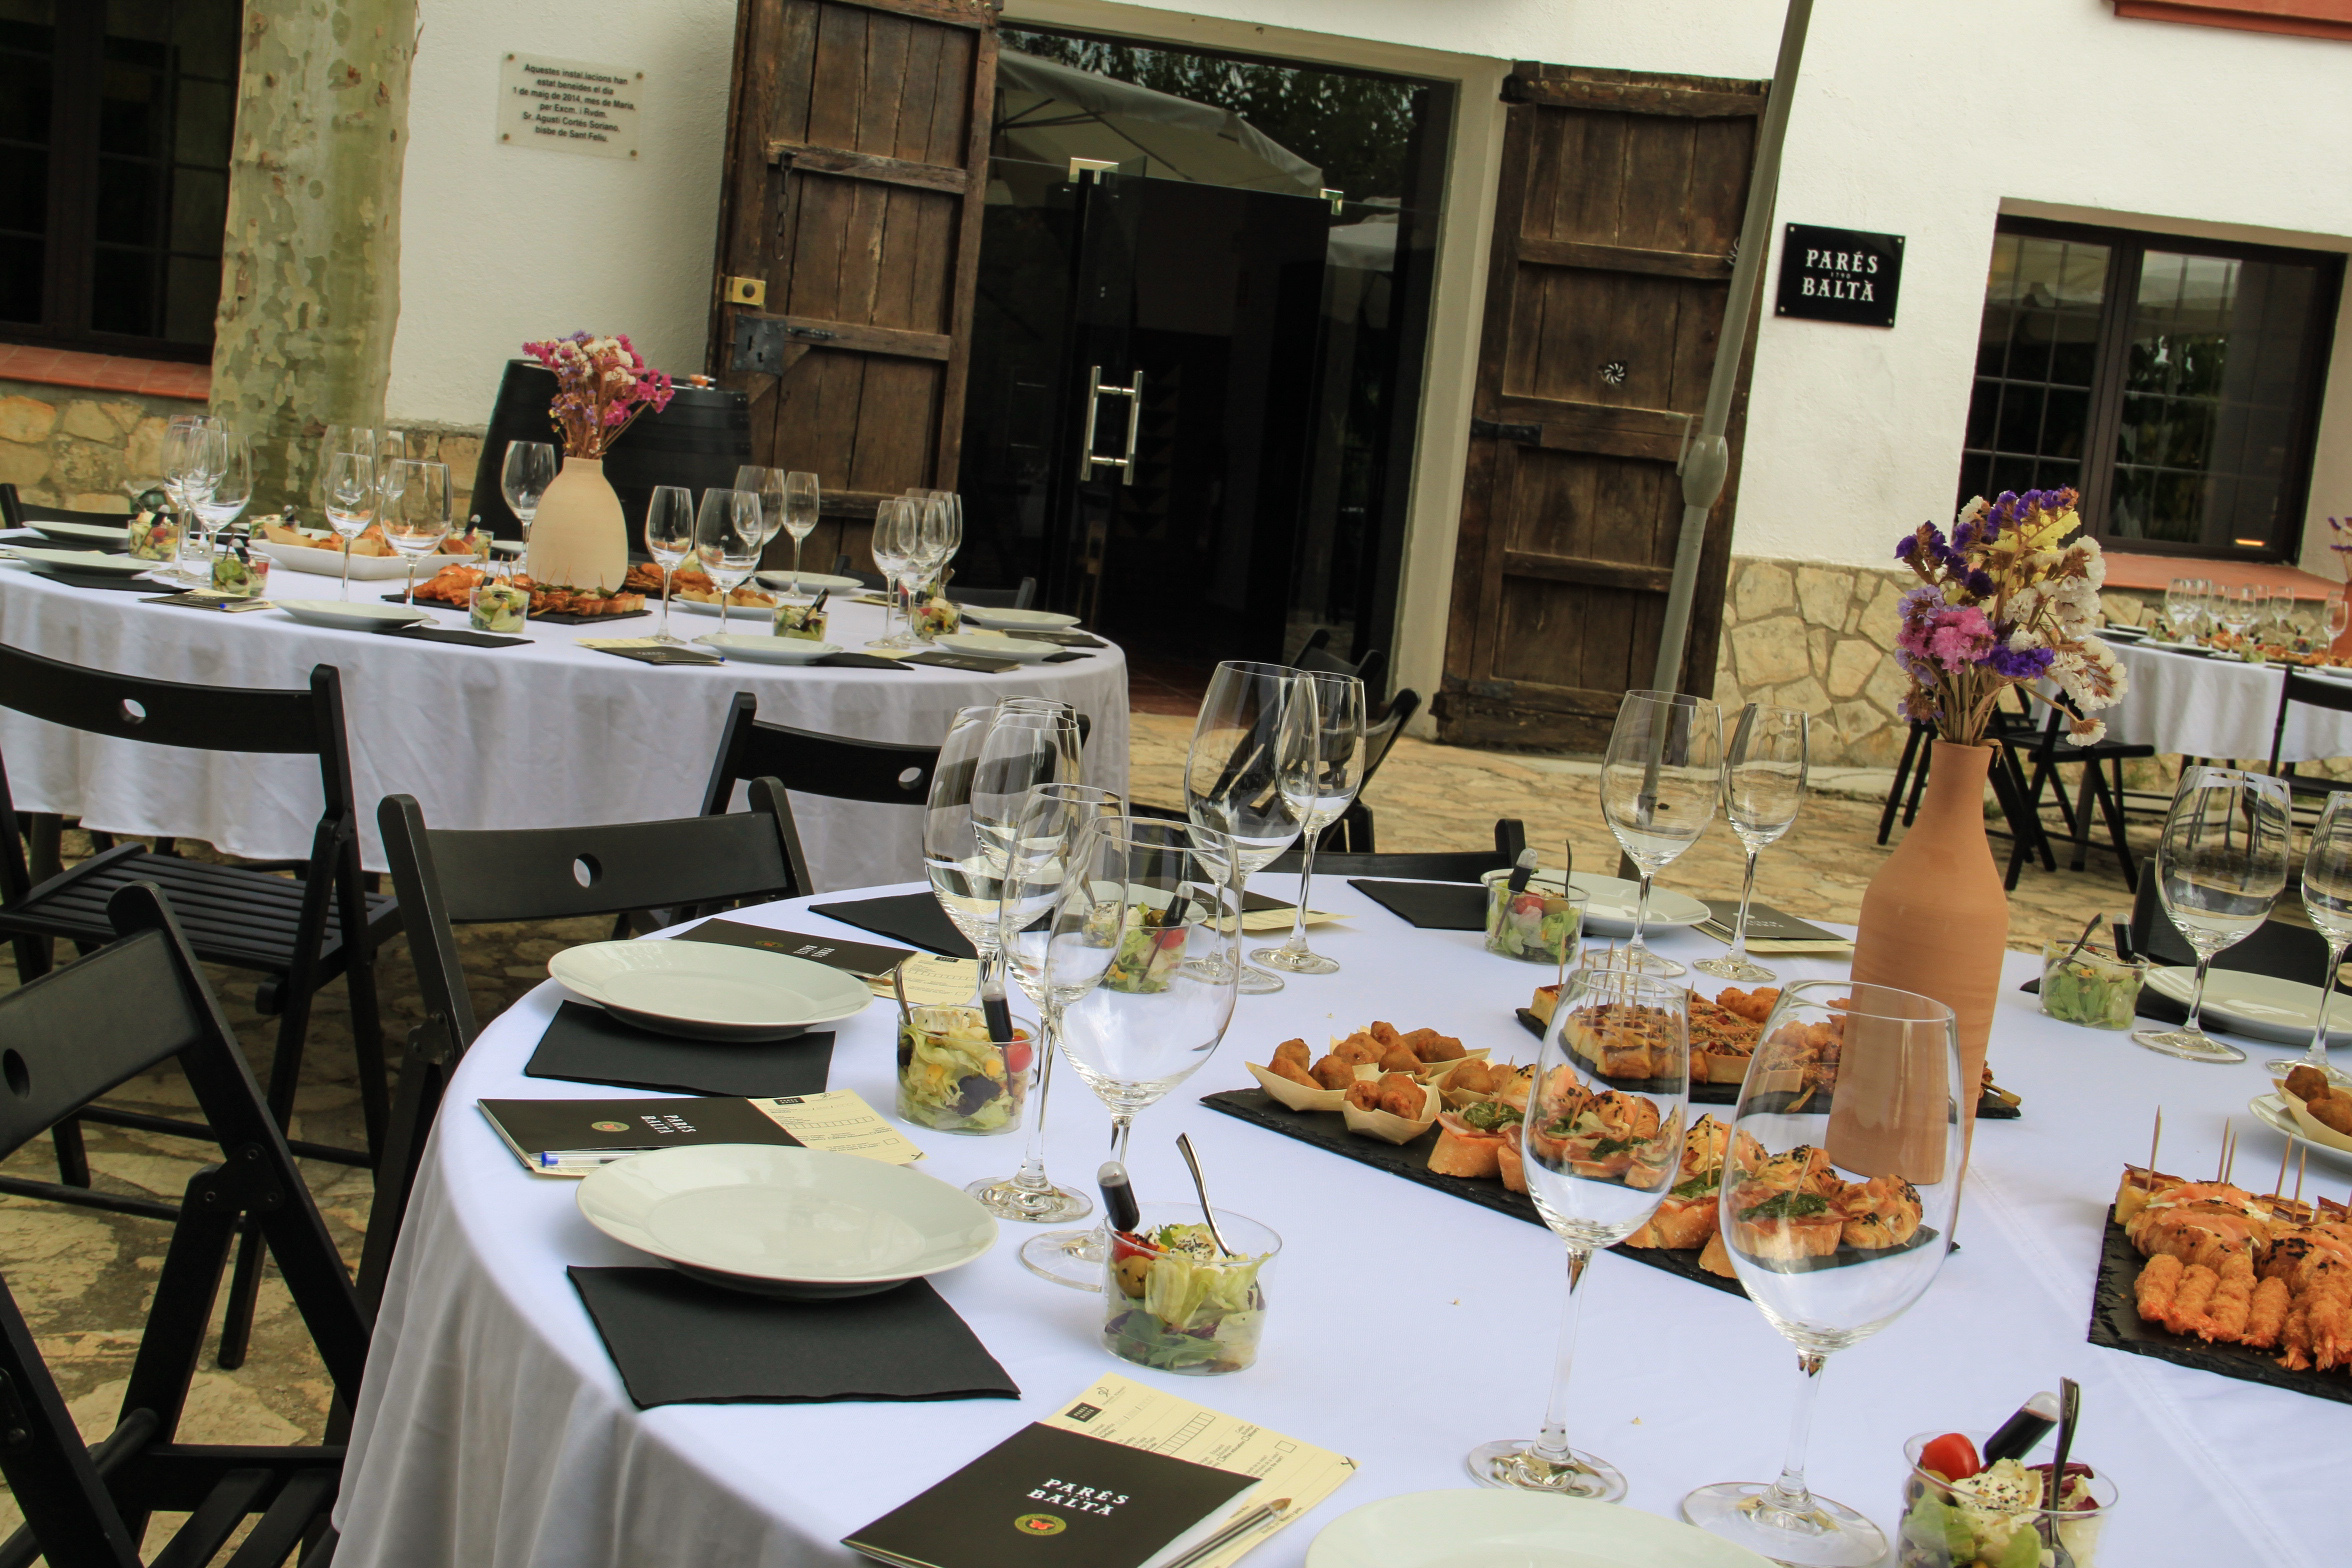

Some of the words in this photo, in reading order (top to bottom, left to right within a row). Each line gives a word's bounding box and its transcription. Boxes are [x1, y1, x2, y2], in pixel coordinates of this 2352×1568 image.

[524, 64, 560, 76] Aquestes
[614, 76, 628, 85] han
[537, 79, 556, 87] estat
[593, 85, 601, 93] el
[530, 89, 549, 100] maig
[551, 91, 561, 100] de
[562, 93, 582, 103] 2014,
[584, 97, 600, 105] mes
[602, 98, 611, 106] de
[539, 103, 552, 112] per
[554, 104, 578, 114] Excm.
[584, 108, 608, 118] Rvdm.
[523, 112, 534, 120] Sr.
[562, 117, 587, 128] Cortés
[589, 120, 620, 132] Soriano,
[535, 126, 556, 136] bisbe
[558, 128, 568, 137] de
[569, 129, 586, 139] Sant
[588, 132, 609, 142] Feliu.
[1805, 249, 1878, 274] PARÉS
[1801, 277, 1874, 302] BALTÀ
[1042, 1478, 1130, 1505] PARÉS
[1027, 1488, 1114, 1516] BALTÀ
